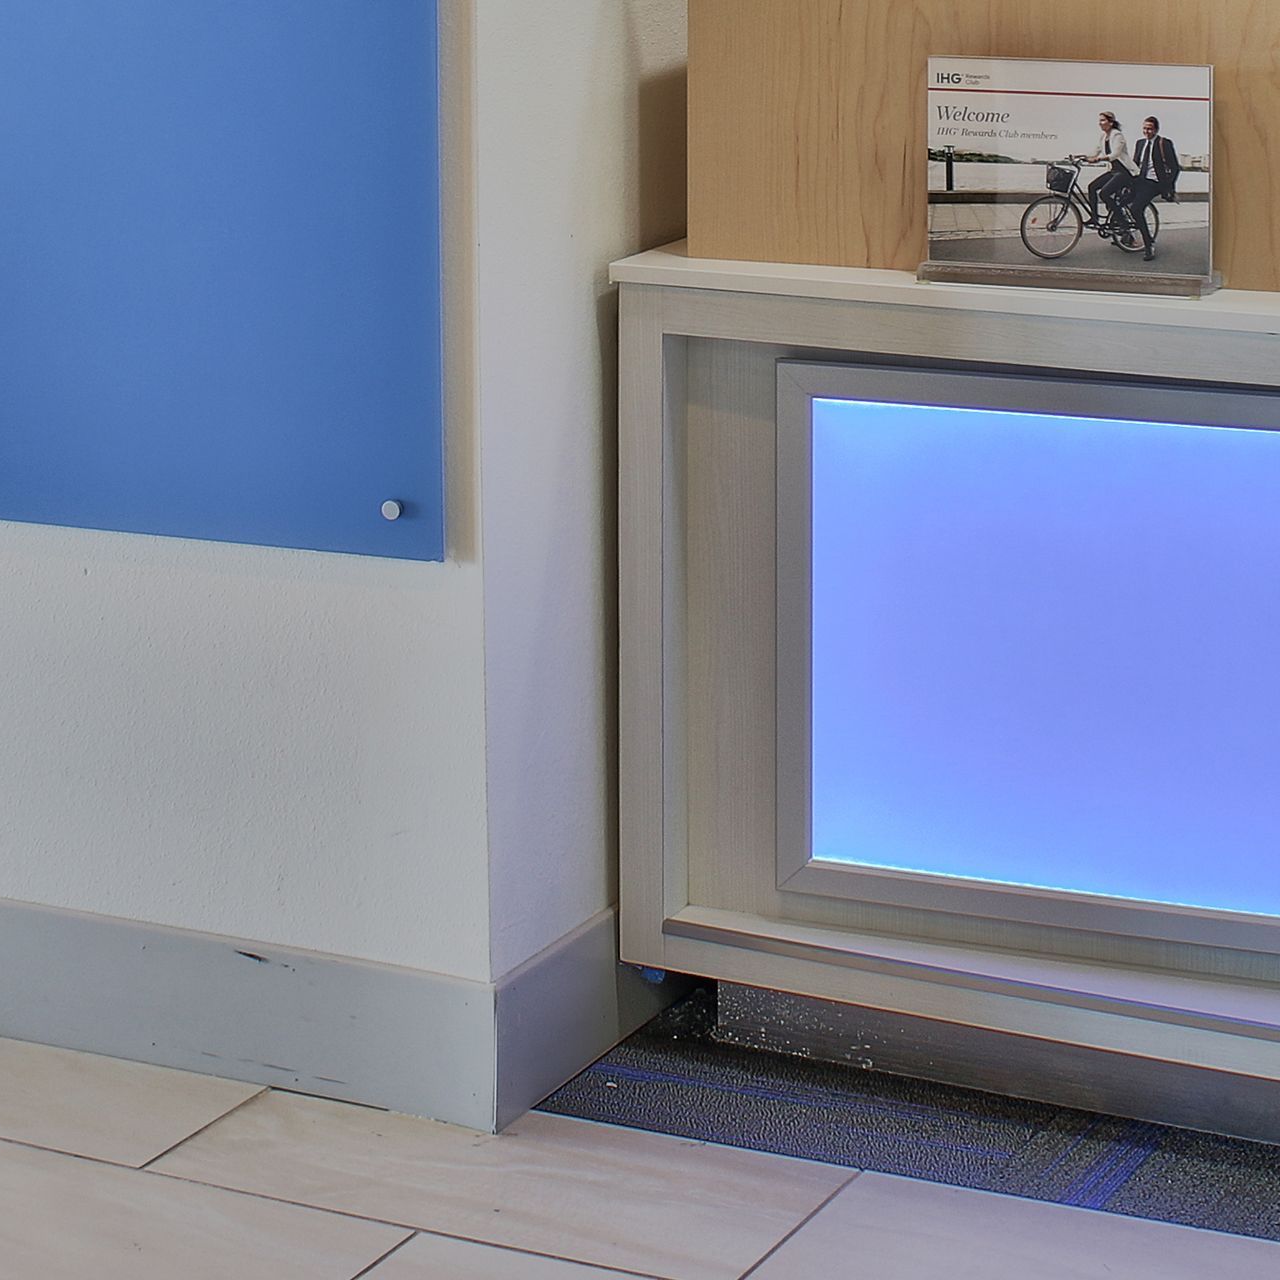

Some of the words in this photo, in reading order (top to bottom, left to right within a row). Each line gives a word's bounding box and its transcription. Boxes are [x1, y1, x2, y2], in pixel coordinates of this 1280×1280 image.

[936, 72, 962, 84] IHG
[936, 105, 1010, 123] Welcome
[961, 128, 997, 137] Rewards
[998, 129, 1019, 139] Club
[1020, 131, 1058, 140] members
